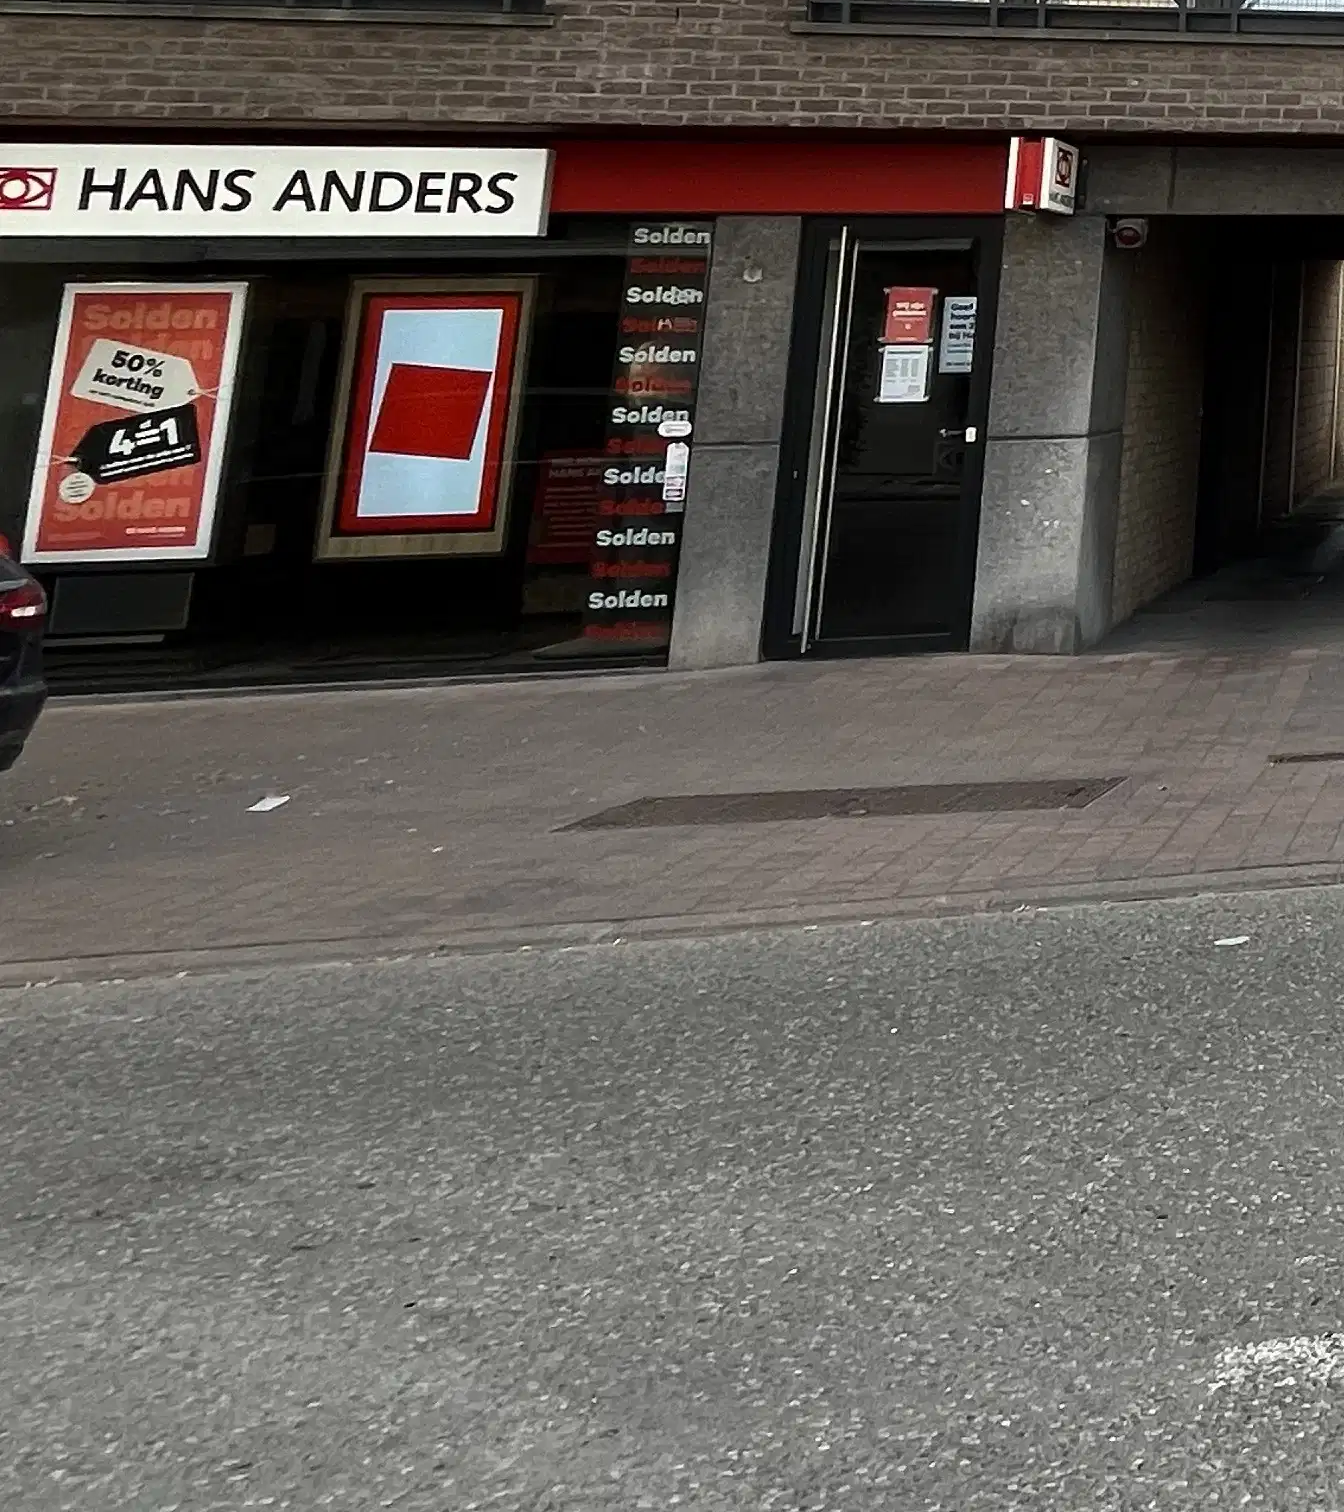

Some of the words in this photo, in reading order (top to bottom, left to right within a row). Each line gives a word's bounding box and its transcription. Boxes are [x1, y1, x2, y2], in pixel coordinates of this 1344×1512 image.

[78, 167, 256, 211] HANS
[273, 170, 518, 214] ANDERS
[634, 227, 711, 244] Solden
[627, 286, 704, 304] Solden
[83, 302, 218, 331] Solden
[110, 350, 166, 378] 50%
[619, 346, 696, 363] Solden
[92, 368, 165, 400] korting
[612, 405, 690, 424] Solden
[603, 466, 667, 485] Solde
[53, 490, 191, 522] Solden
[596, 528, 676, 546] Solden
[588, 590, 668, 609] Solden
